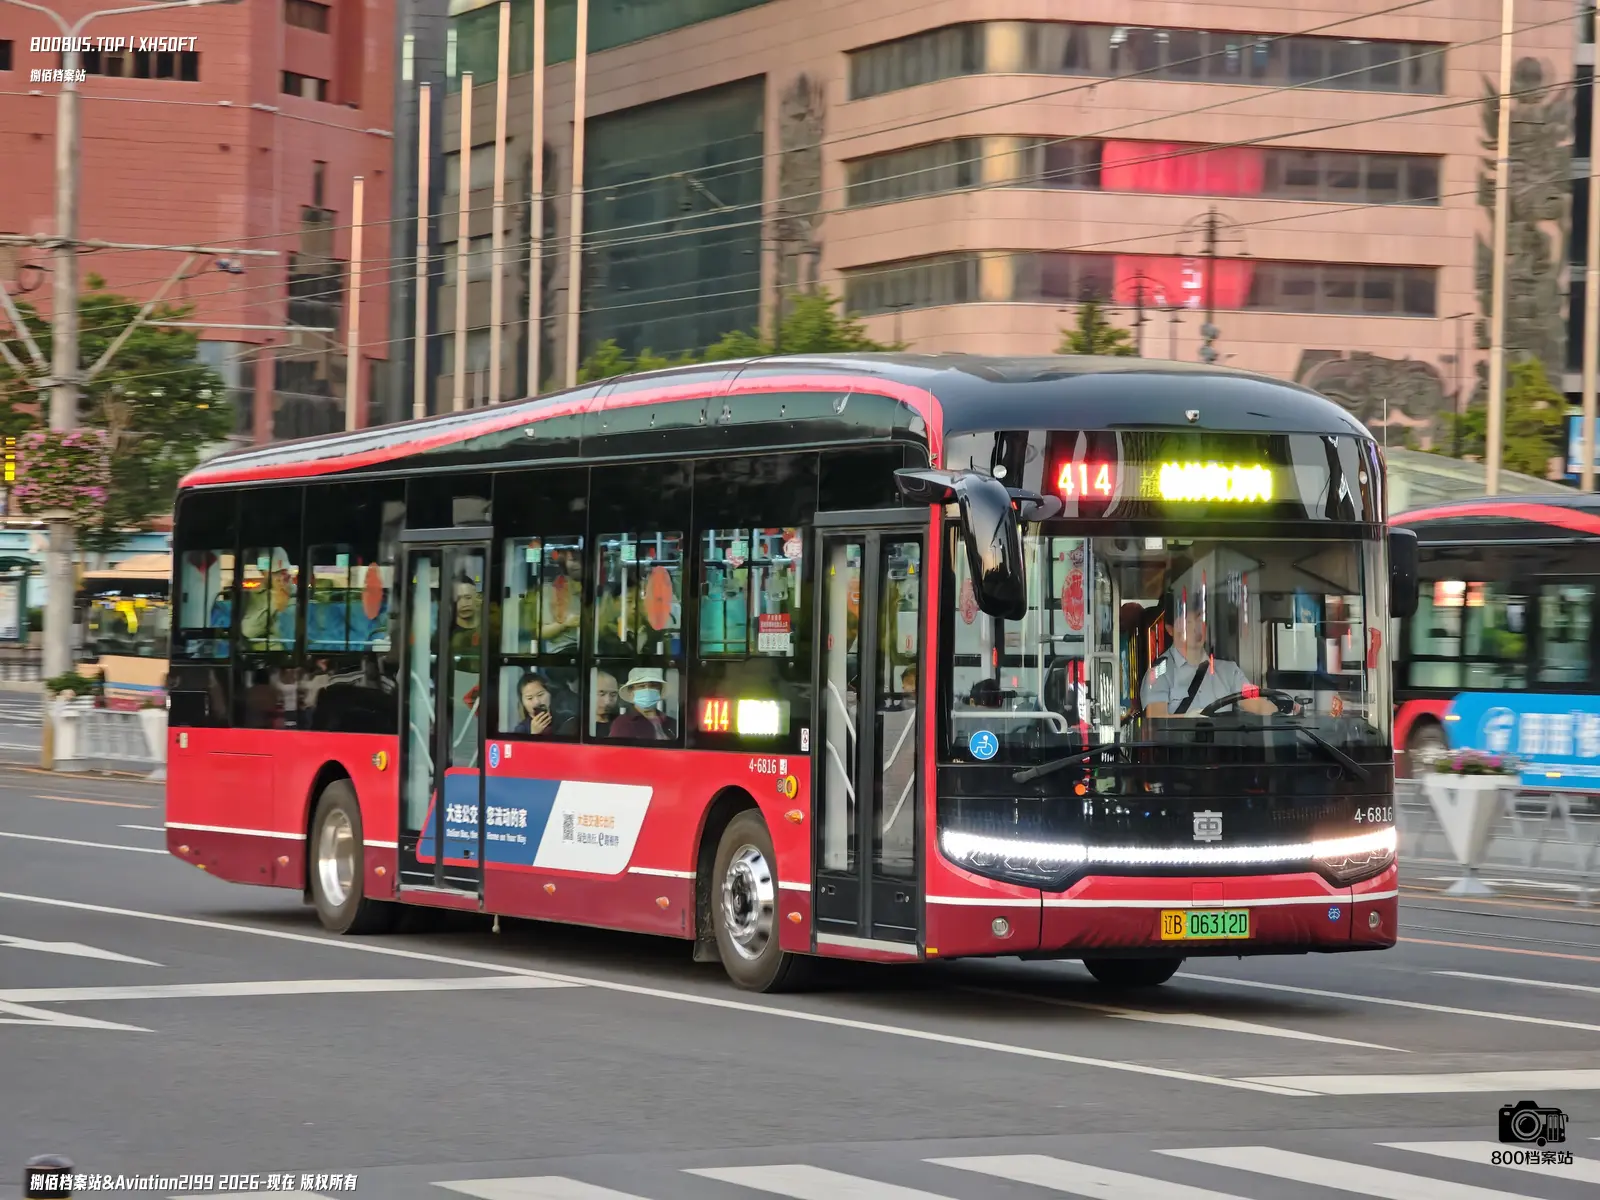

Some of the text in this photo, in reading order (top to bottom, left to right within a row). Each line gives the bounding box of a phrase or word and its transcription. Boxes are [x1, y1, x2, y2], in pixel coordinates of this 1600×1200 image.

[1058, 462, 1112, 496] 414
[703, 700, 730, 732] 414
[749, 758, 777, 774] 4-6816
[446, 803, 479, 824] 大连公交
[1354, 805, 1393, 824] 4-6816
[1190, 913, 1248, 935] 06312D
